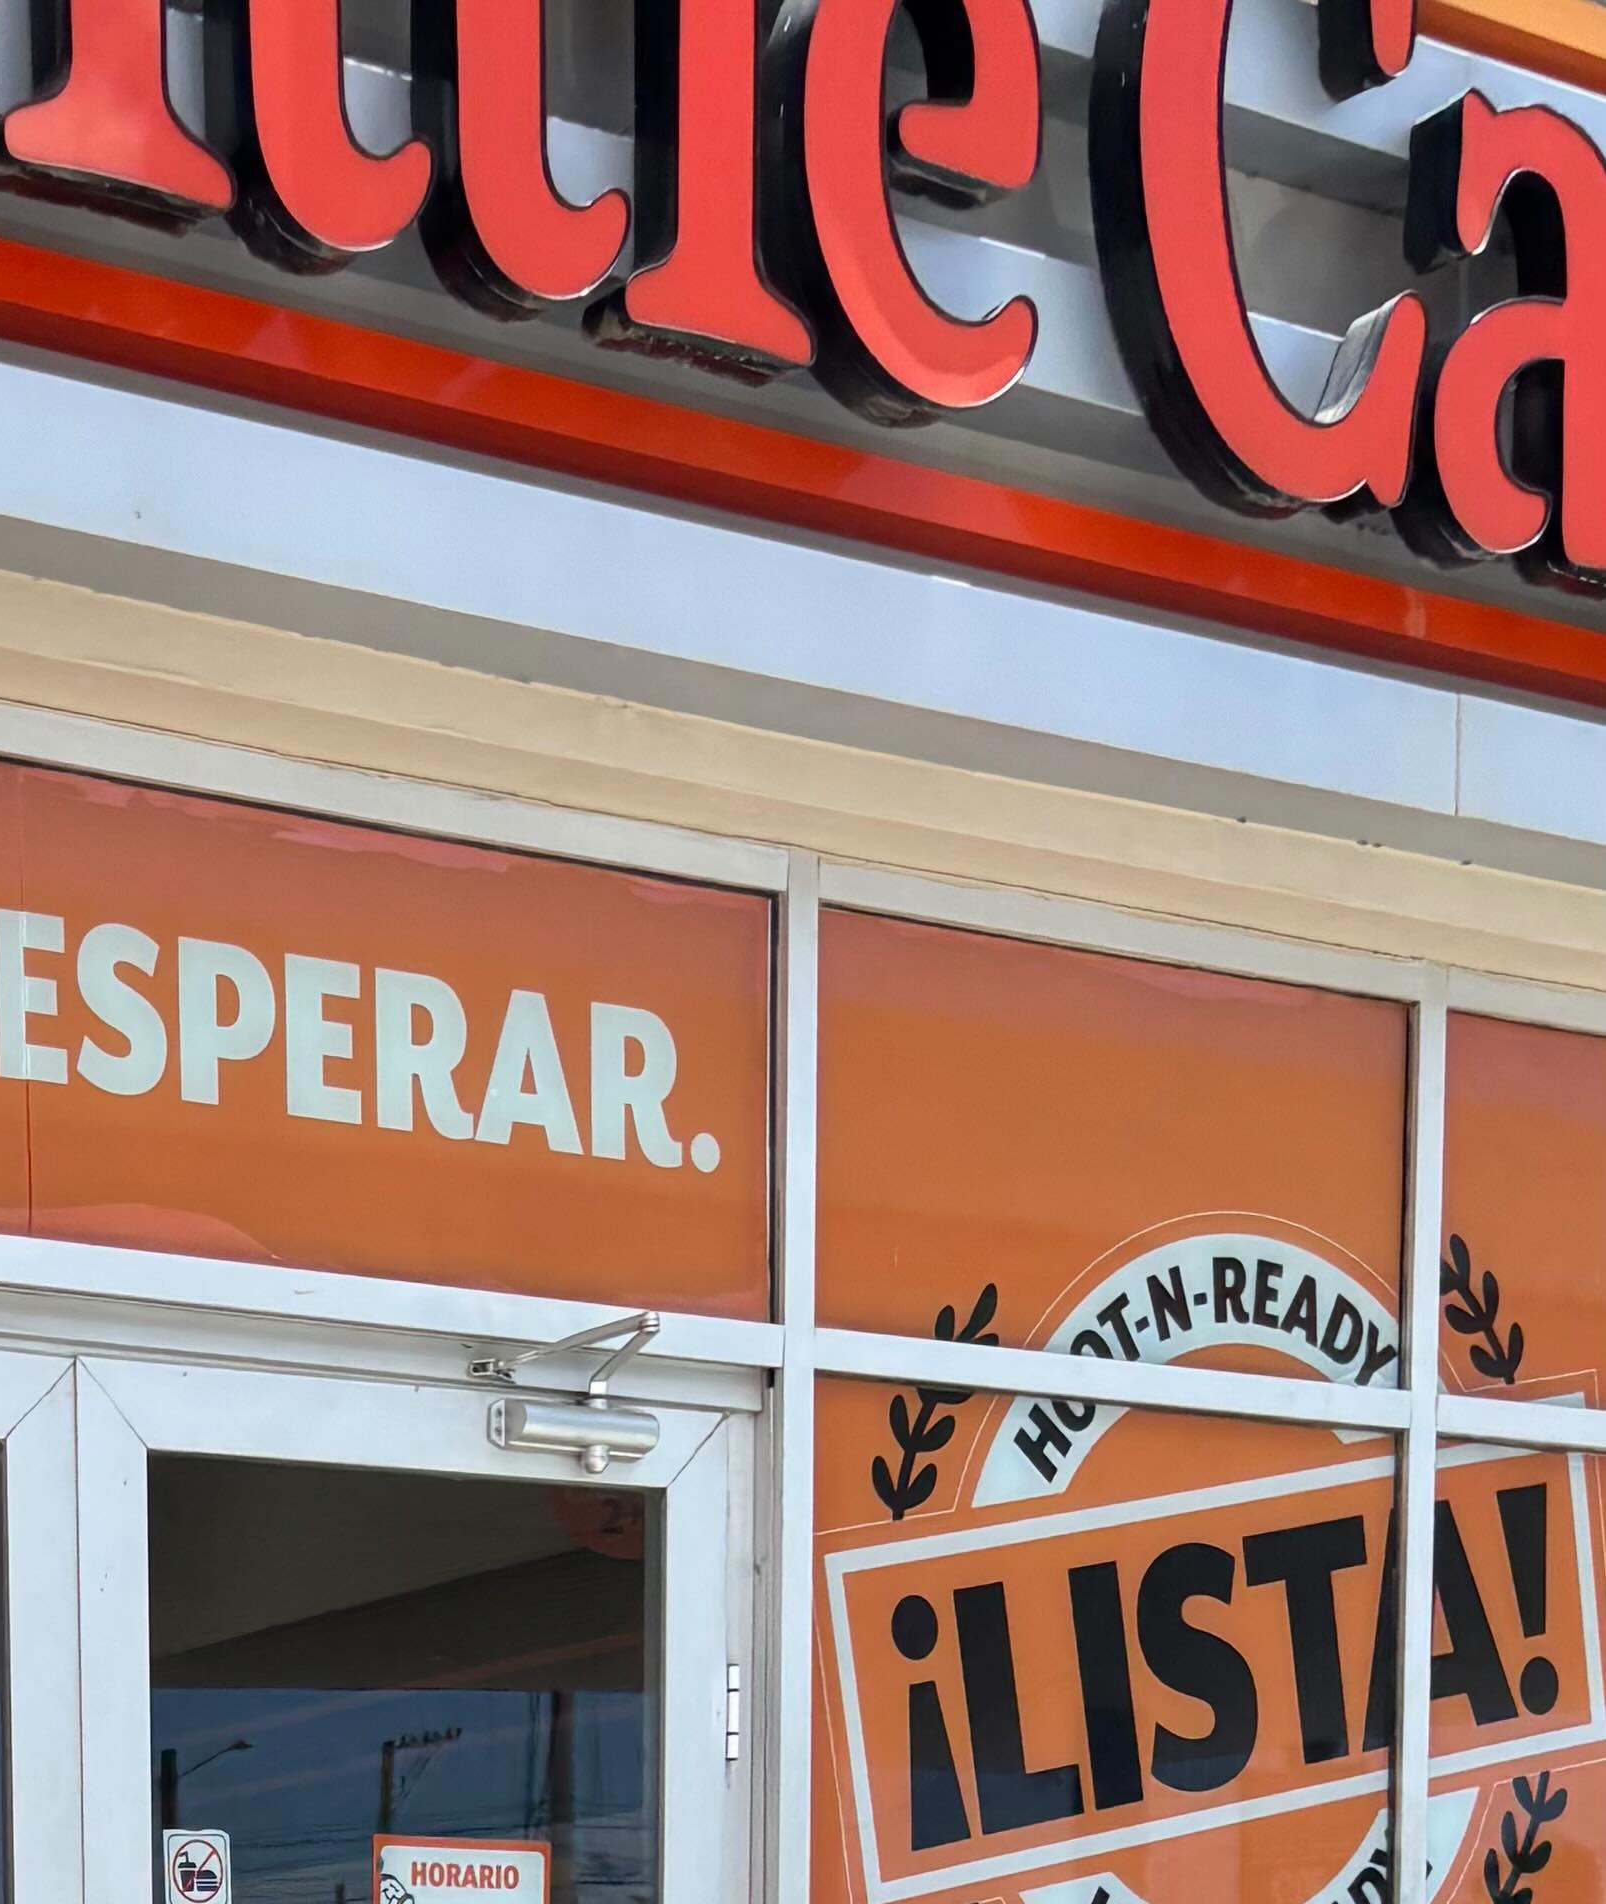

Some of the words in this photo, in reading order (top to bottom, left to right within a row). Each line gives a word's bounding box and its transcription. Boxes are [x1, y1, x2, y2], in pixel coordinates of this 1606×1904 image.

[1139, 0, 1606, 572] Ca
[1014, 1256, 1398, 1484] HOT-N-READY
[891, 1483, 1560, 1852] ¡LISTA!
[410, 1861, 520, 1889] HORARIO
